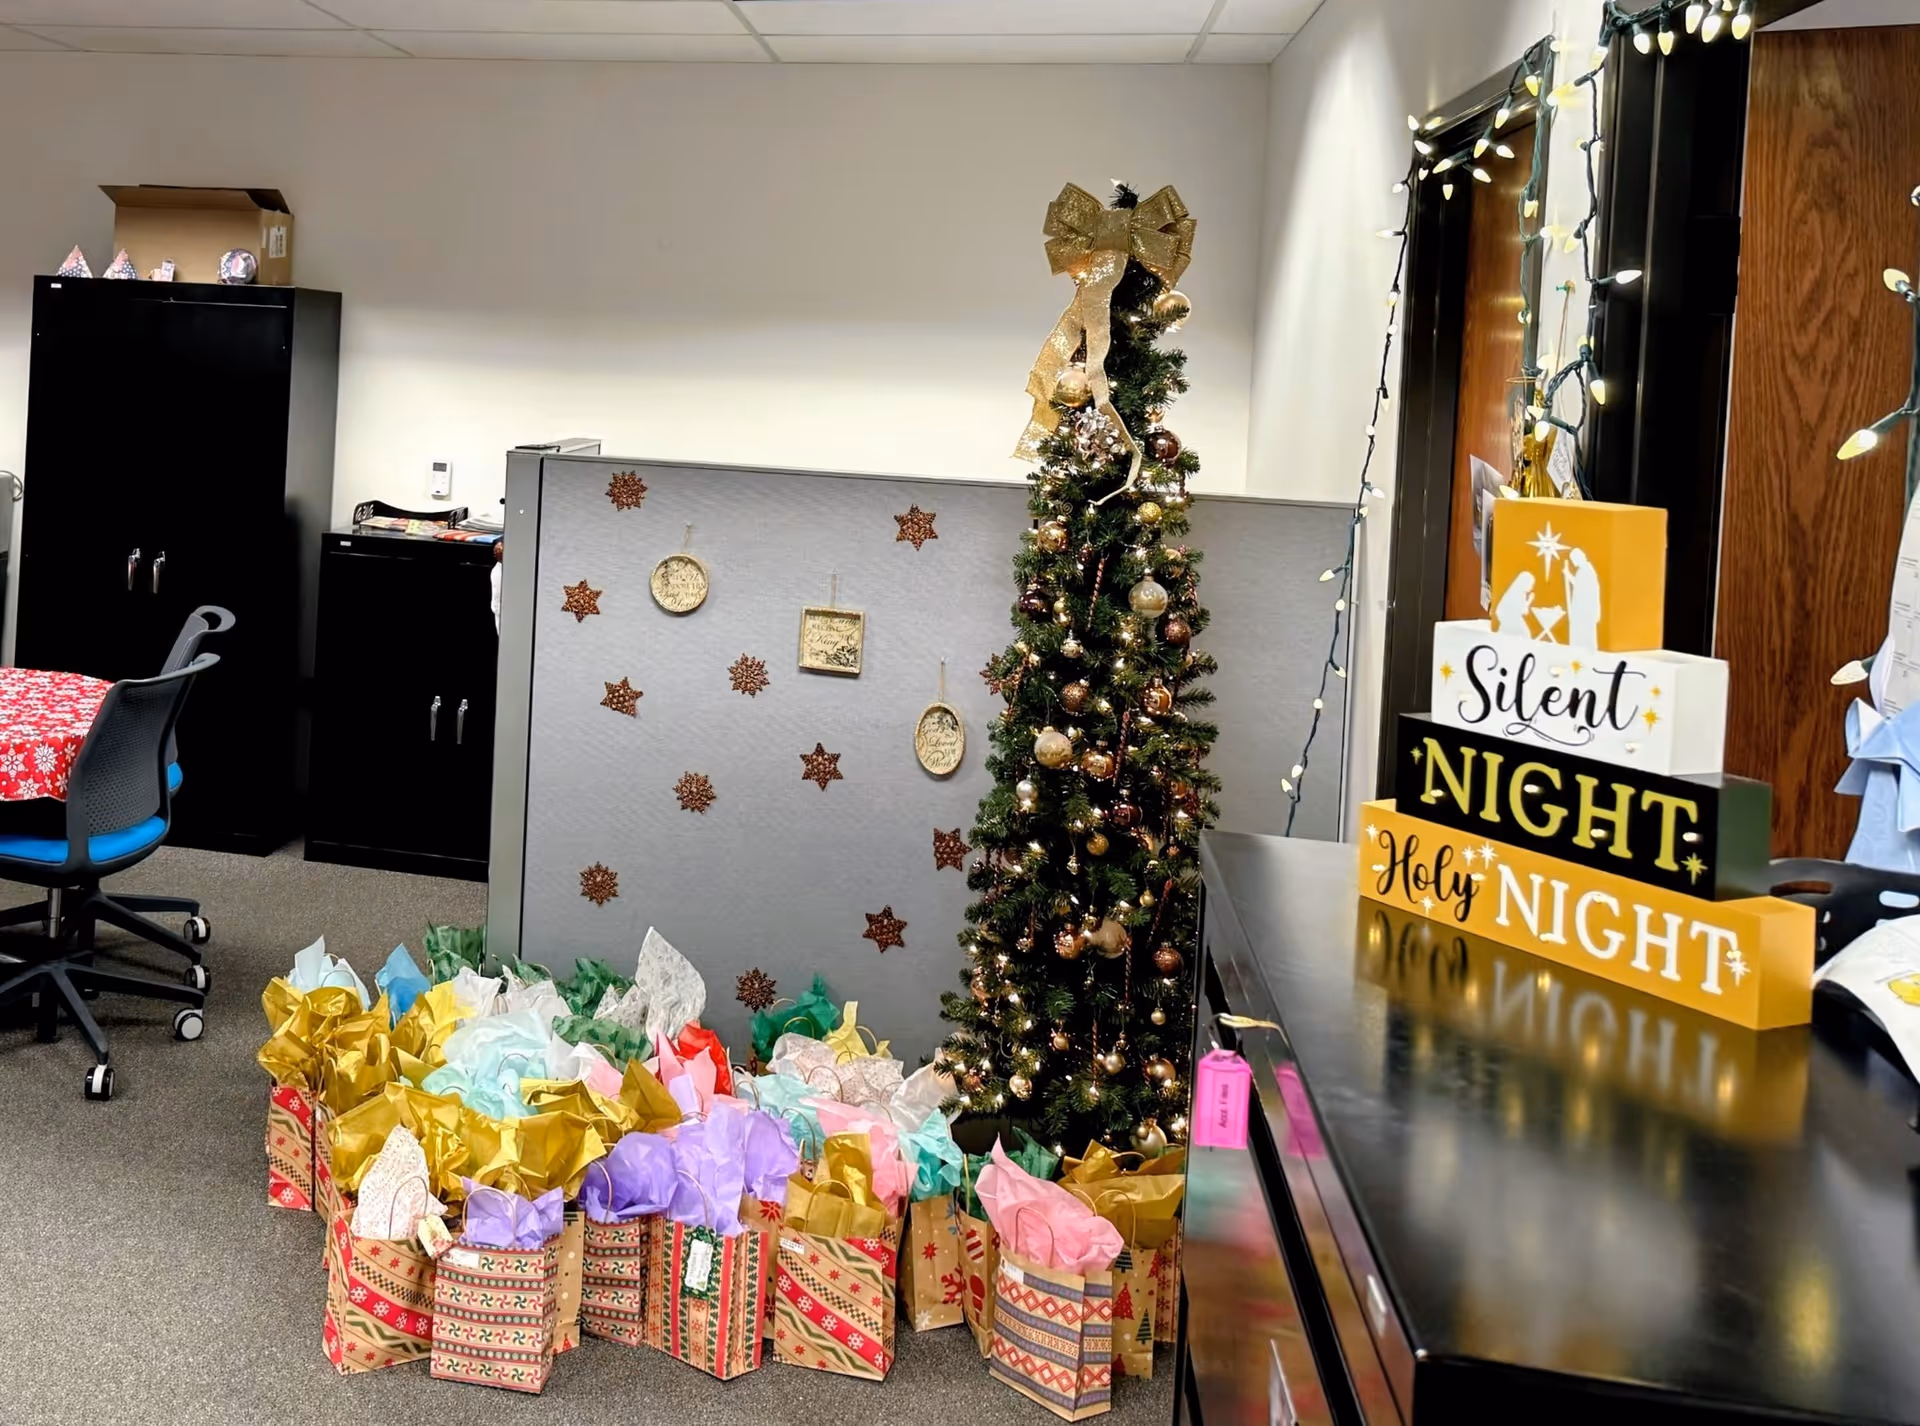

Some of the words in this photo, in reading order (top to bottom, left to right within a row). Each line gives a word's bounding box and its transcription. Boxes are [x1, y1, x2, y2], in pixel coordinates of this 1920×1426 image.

[1457, 643, 1647, 746] Silent
[1419, 737, 1698, 871] NIGHT
[1375, 830, 1480, 922] Holy
[1495, 864, 1739, 995] NIGHT
